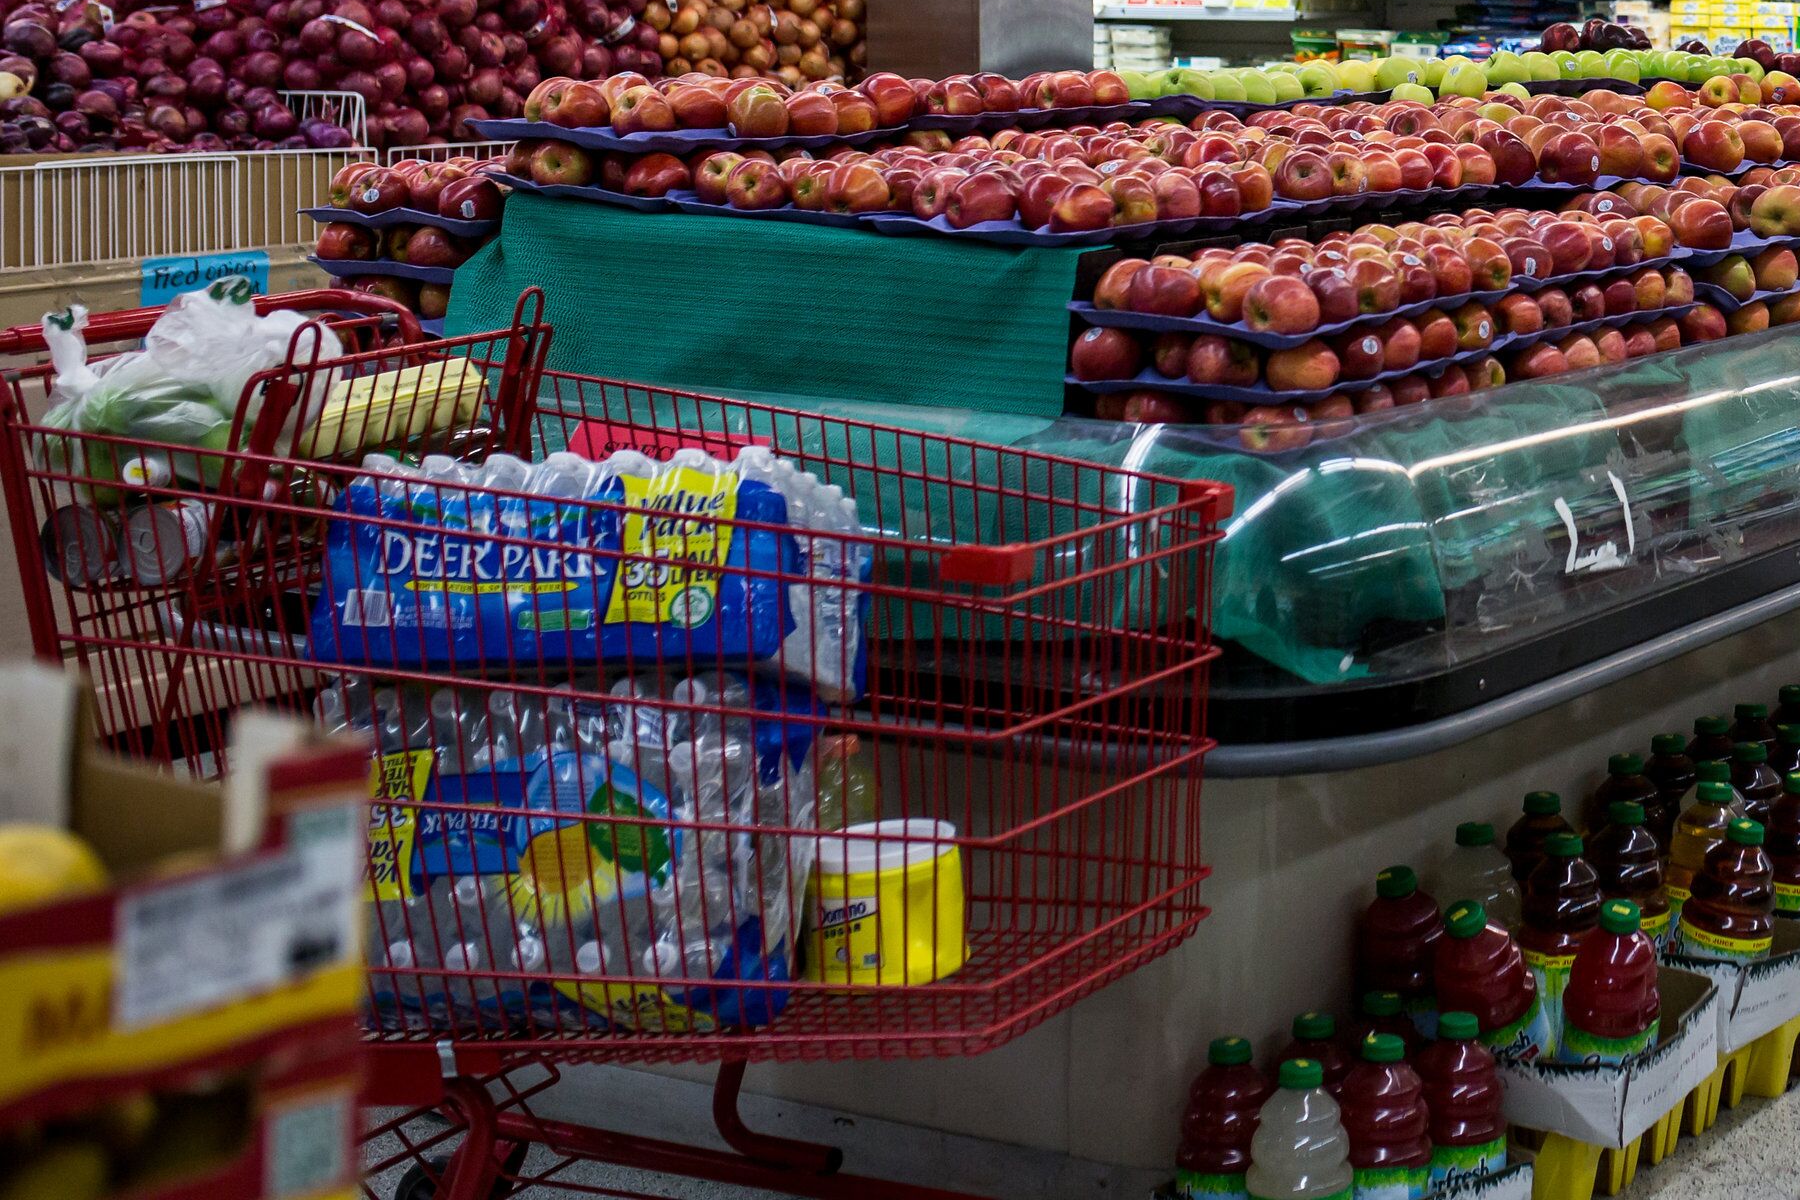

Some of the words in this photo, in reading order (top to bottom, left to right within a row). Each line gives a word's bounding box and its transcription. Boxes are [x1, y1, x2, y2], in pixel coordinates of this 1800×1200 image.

[378, 531, 494, 579] DEER
[495, 533, 608, 579] PARK
[620, 548, 670, 589] 35
[1694, 931, 1712, 943] 100%
[1713, 936, 1734, 948] JUICE
